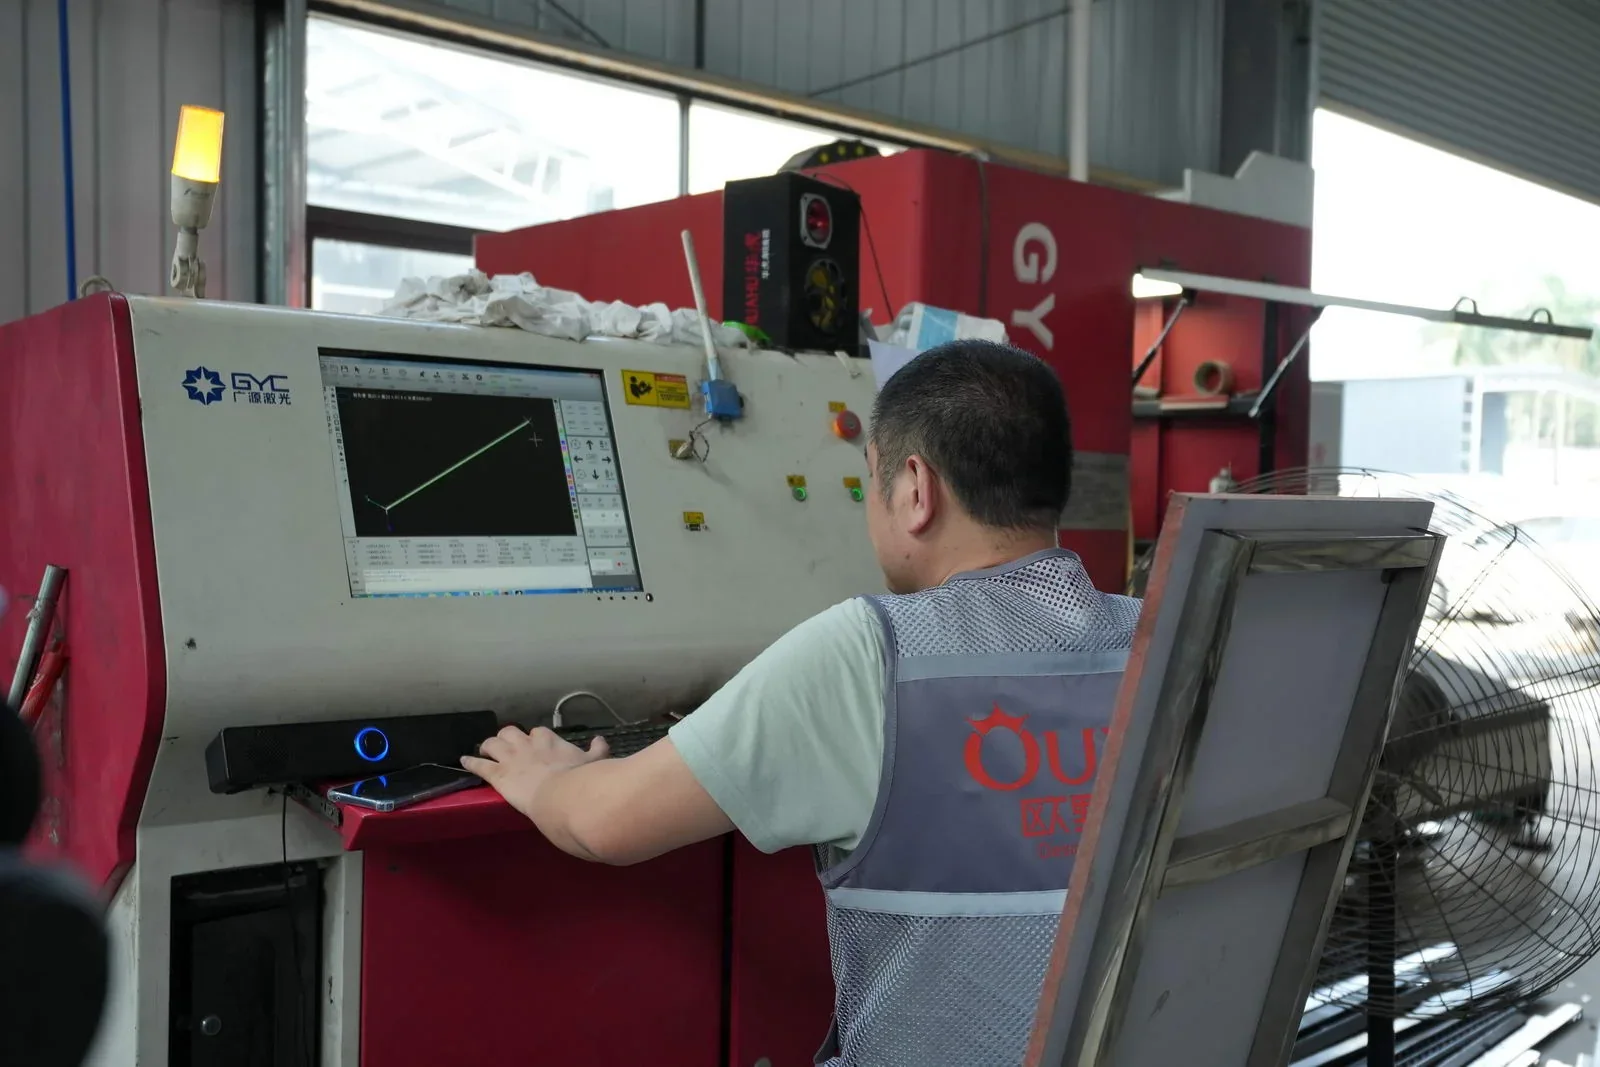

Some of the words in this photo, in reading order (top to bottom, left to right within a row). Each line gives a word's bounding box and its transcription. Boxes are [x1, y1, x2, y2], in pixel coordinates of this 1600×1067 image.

[231, 372, 290, 392] GYC
[234, 391, 291, 405] 广源激光
